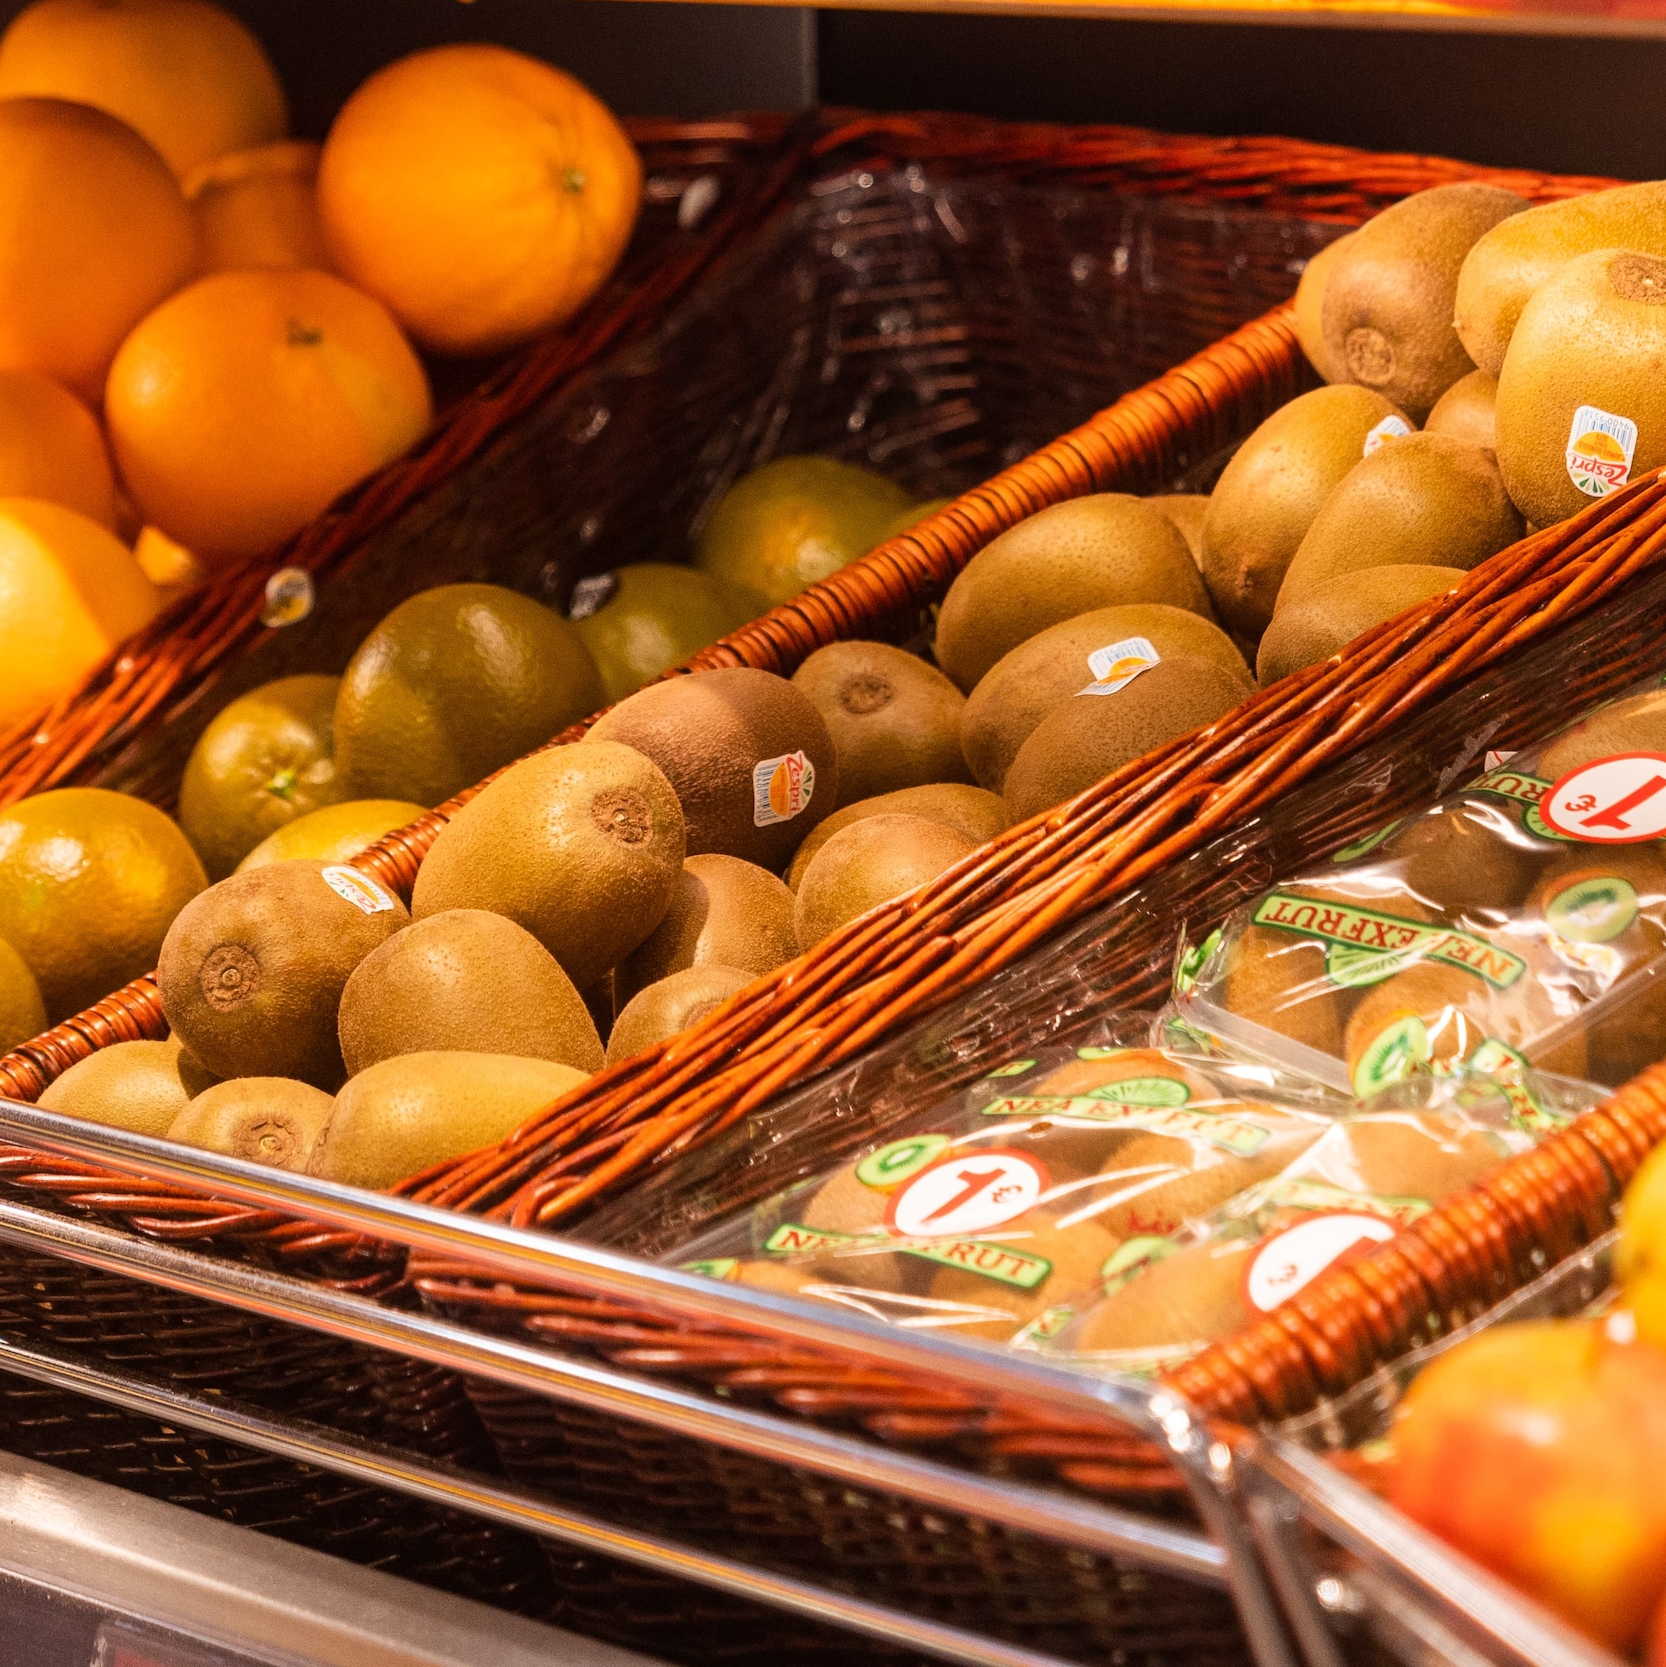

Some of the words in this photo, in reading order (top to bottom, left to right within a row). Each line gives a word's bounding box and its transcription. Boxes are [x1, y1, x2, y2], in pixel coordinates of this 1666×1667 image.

[1569, 454, 1629, 487] Zespri
[786, 752, 804, 812] Zespri
[1264, 902, 1421, 950] EXFRUT
[995, 1099, 1073, 1113] NEA
